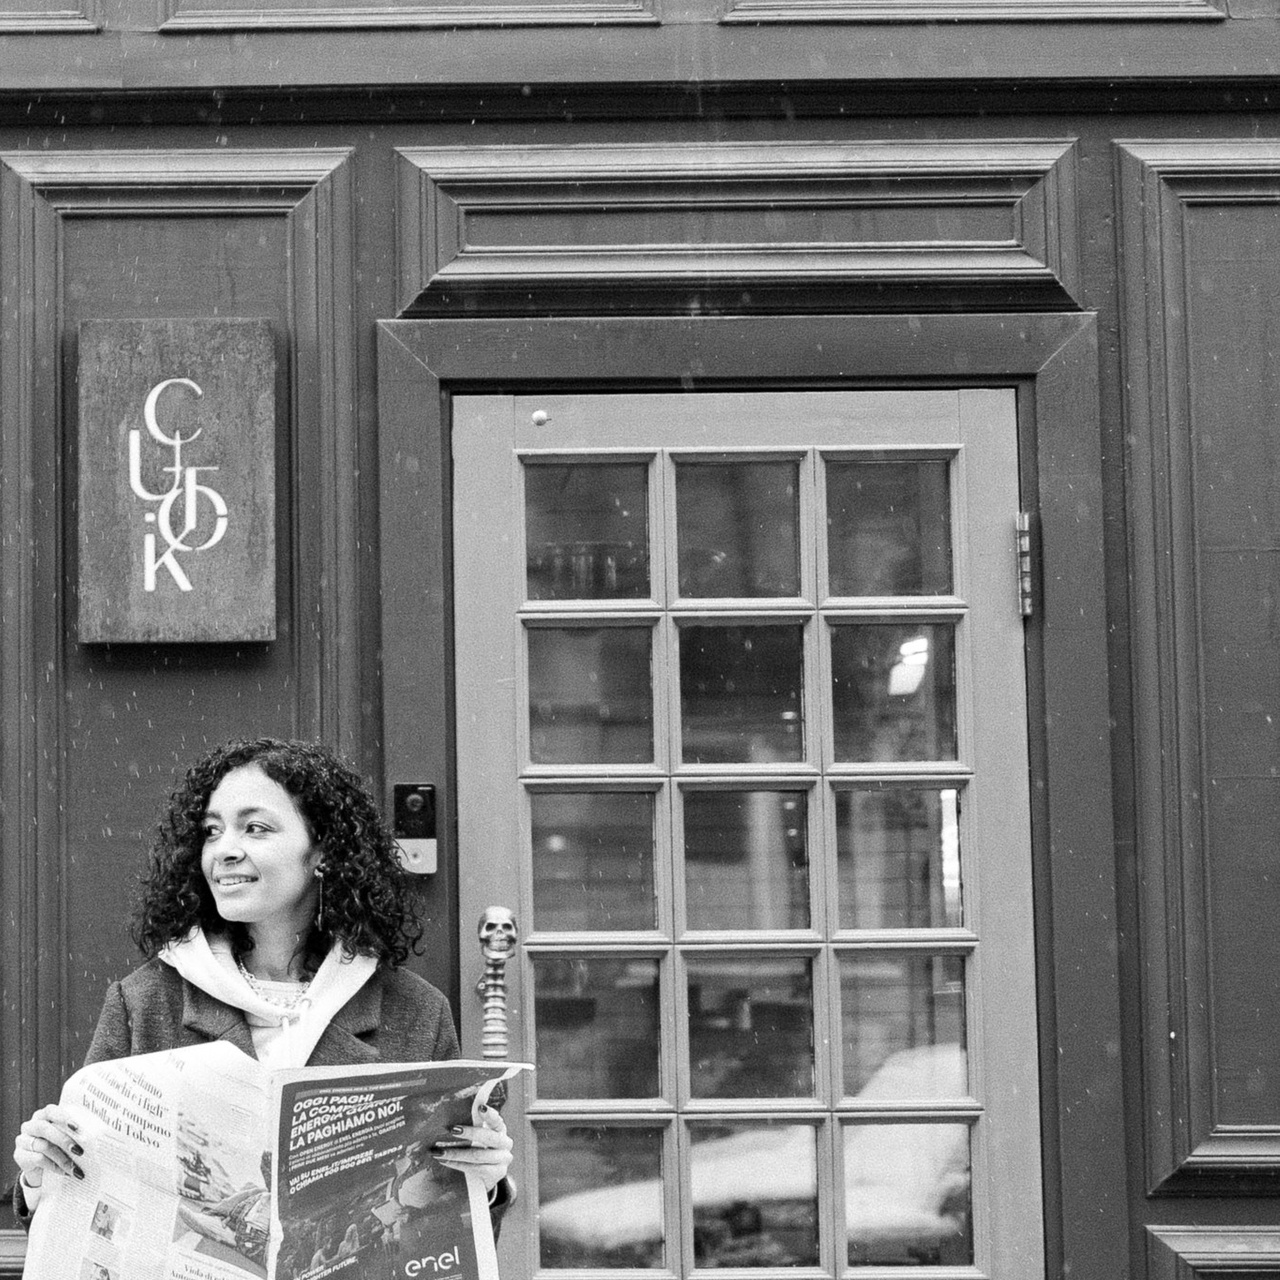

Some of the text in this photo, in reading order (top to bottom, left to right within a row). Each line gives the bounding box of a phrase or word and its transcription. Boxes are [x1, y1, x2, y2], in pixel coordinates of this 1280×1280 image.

[292, 1111, 307, 1126] LA
[293, 1096, 328, 1113] OGGI
[330, 1094, 374, 1104] PAGHI
[91, 1100, 110, 1125] bolla
[112, 1118, 122, 1132] di
[124, 1122, 160, 1148] Tokyo
[122, 1108, 171, 1138] rompono
[289, 1137, 305, 1151] LA
[307, 1110, 375, 1144] PAGHIAMO
[378, 1101, 404, 1119] NOI.
[289, 1175, 300, 1186] VAI
[405, 1246, 460, 1277] enel
